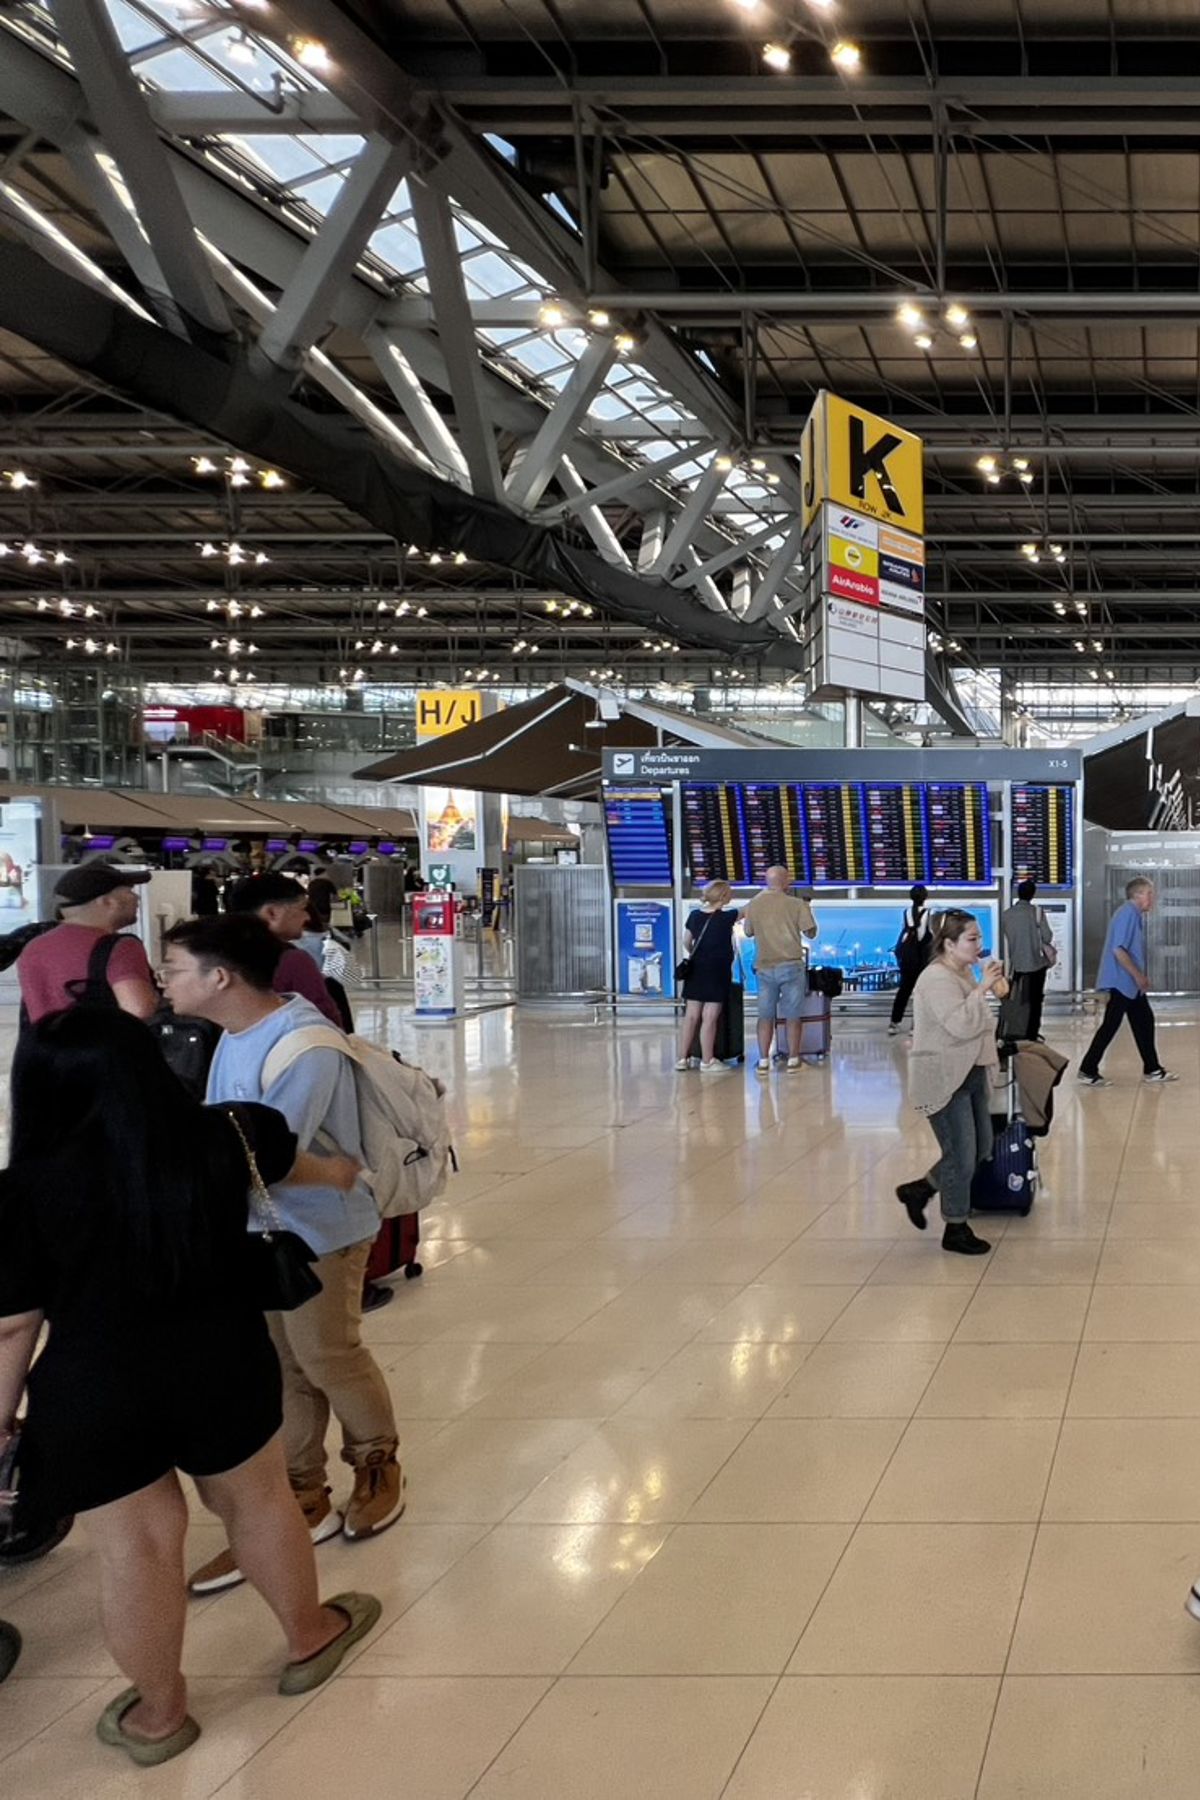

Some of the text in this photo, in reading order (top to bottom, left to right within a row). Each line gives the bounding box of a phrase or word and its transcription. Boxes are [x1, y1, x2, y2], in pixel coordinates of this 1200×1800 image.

[804, 418, 815, 508] J
[848, 414, 906, 517] K
[832, 574, 875, 596] AirArabia
[421, 699, 476, 725] H/J
[641, 766, 690, 776] Departures
